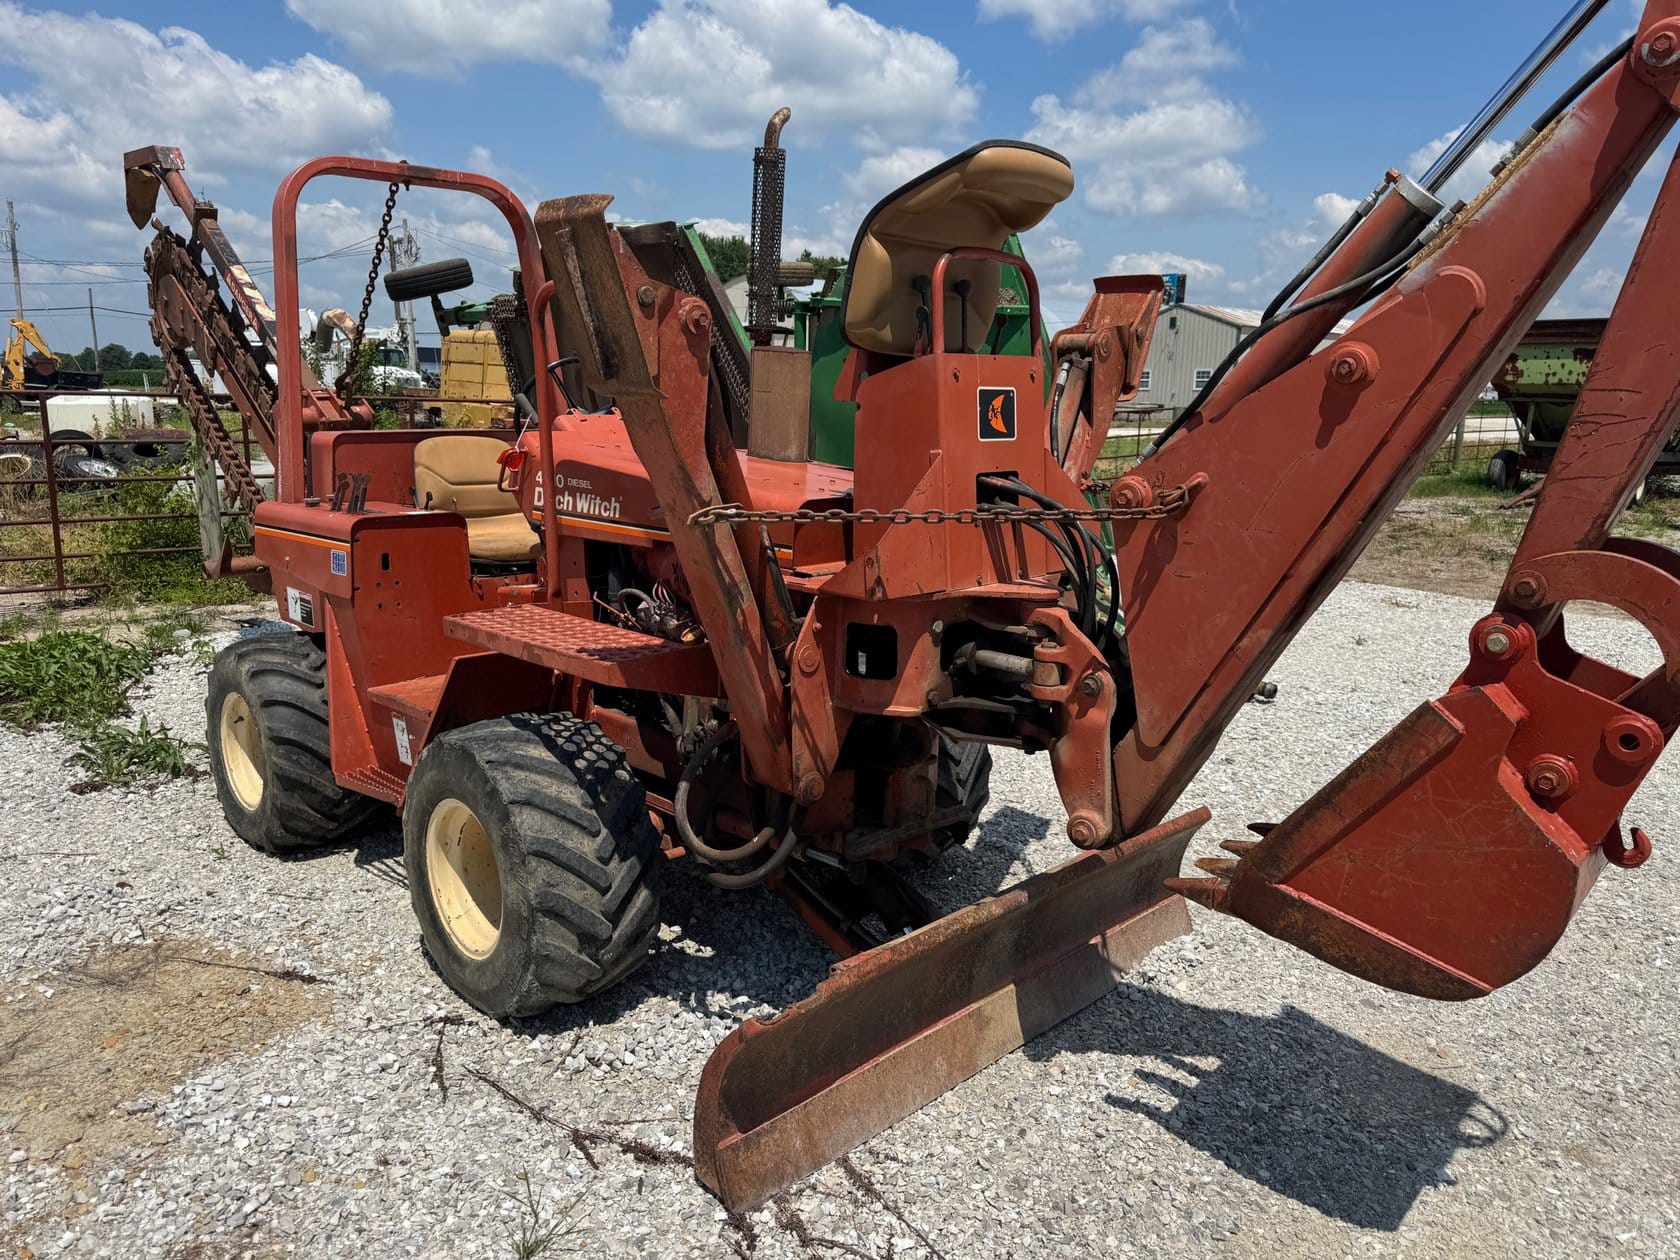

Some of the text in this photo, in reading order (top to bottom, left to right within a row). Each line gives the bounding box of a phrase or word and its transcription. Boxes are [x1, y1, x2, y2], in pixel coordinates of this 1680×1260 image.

[568, 477, 592, 489] DIESEL
[533, 486, 620, 518] Dch Witch
